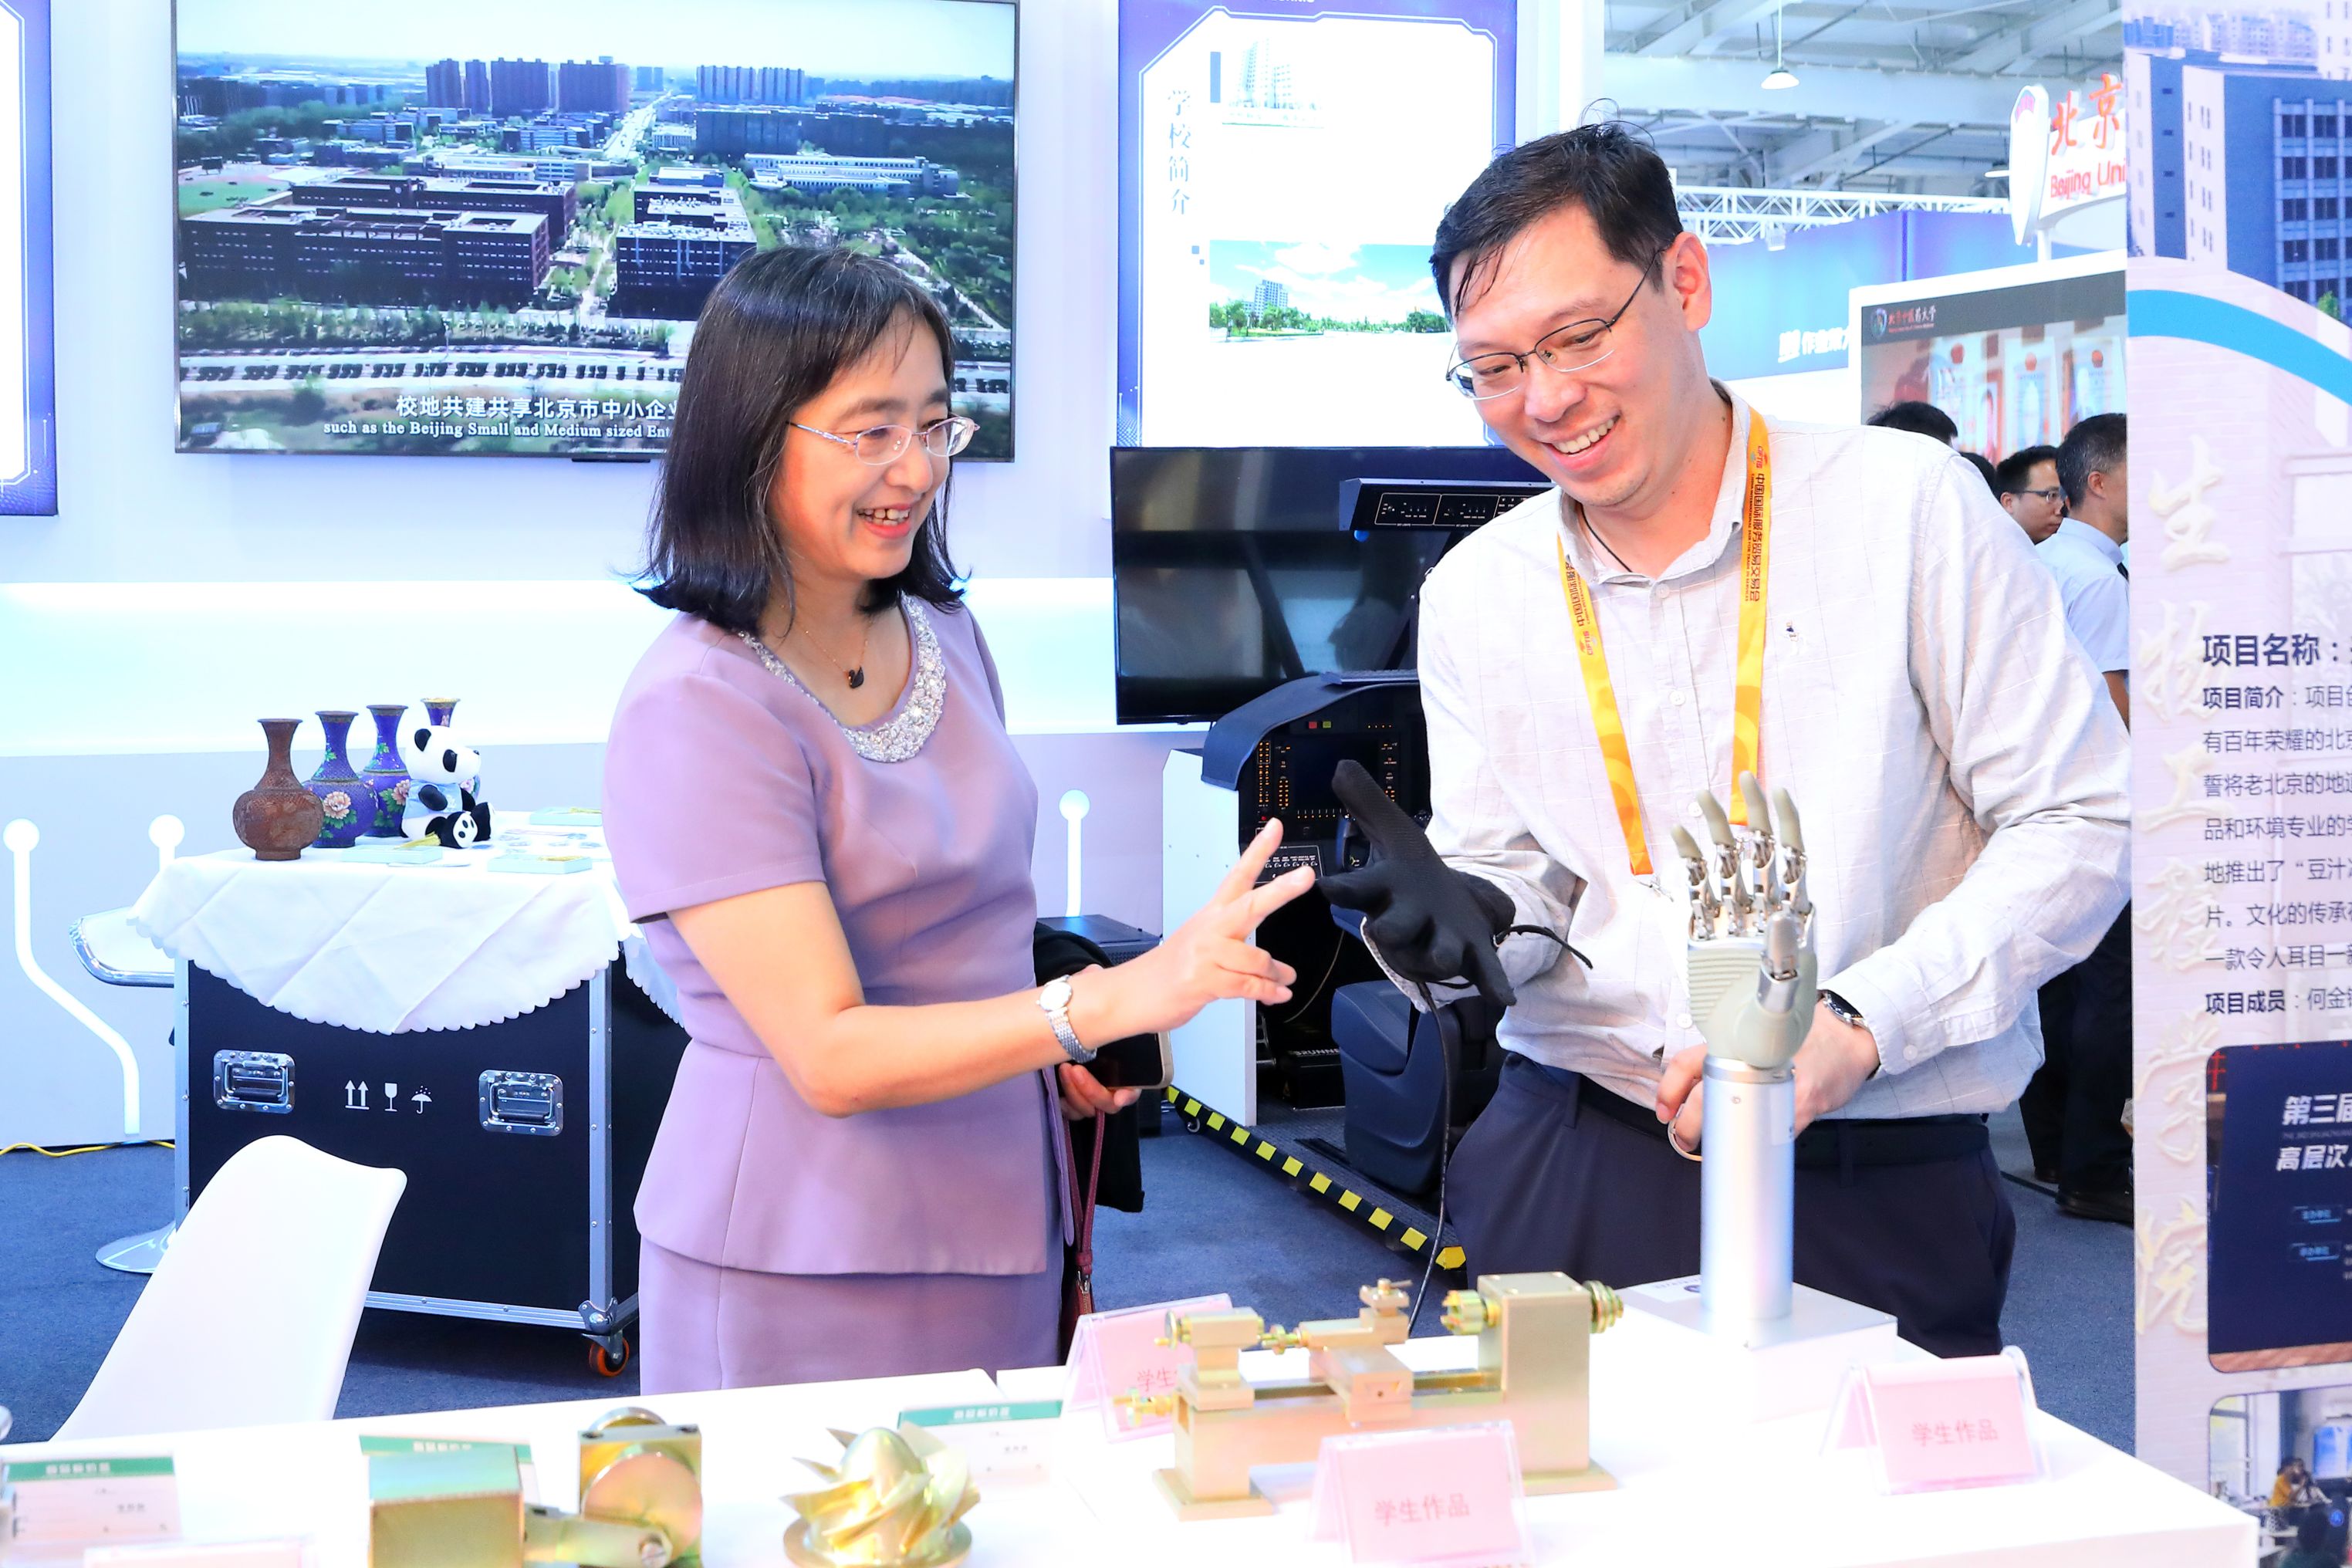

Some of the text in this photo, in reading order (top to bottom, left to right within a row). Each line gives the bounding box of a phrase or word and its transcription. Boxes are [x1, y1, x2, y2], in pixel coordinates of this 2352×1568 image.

[2051, 73, 2123, 155] 北京
[1167, 90, 1191, 215] 学校简介
[2050, 169, 2092, 200] Beijing
[323, 421, 357, 434] such
[362, 424, 377, 434] as
[383, 421, 405, 434] the
[410, 421, 463, 438] Beijing
[468, 422, 509, 436] Small
[514, 424, 539, 437] and
[544, 424, 602, 438] Medium
[606, 424, 642, 438] sized
[1750, 473, 1765, 602] 中国国际服务贸易交易会
[2202, 633, 2352, 667] 项目名称：
[2205, 986, 2352, 1015] 项目成员：何金
[2276, 1144, 2352, 1171] 高层次
[1137, 1366, 1178, 1392] 学生
[1911, 1418, 1999, 1447] 学生作品
[1374, 1492, 1470, 1527] 学生作品
